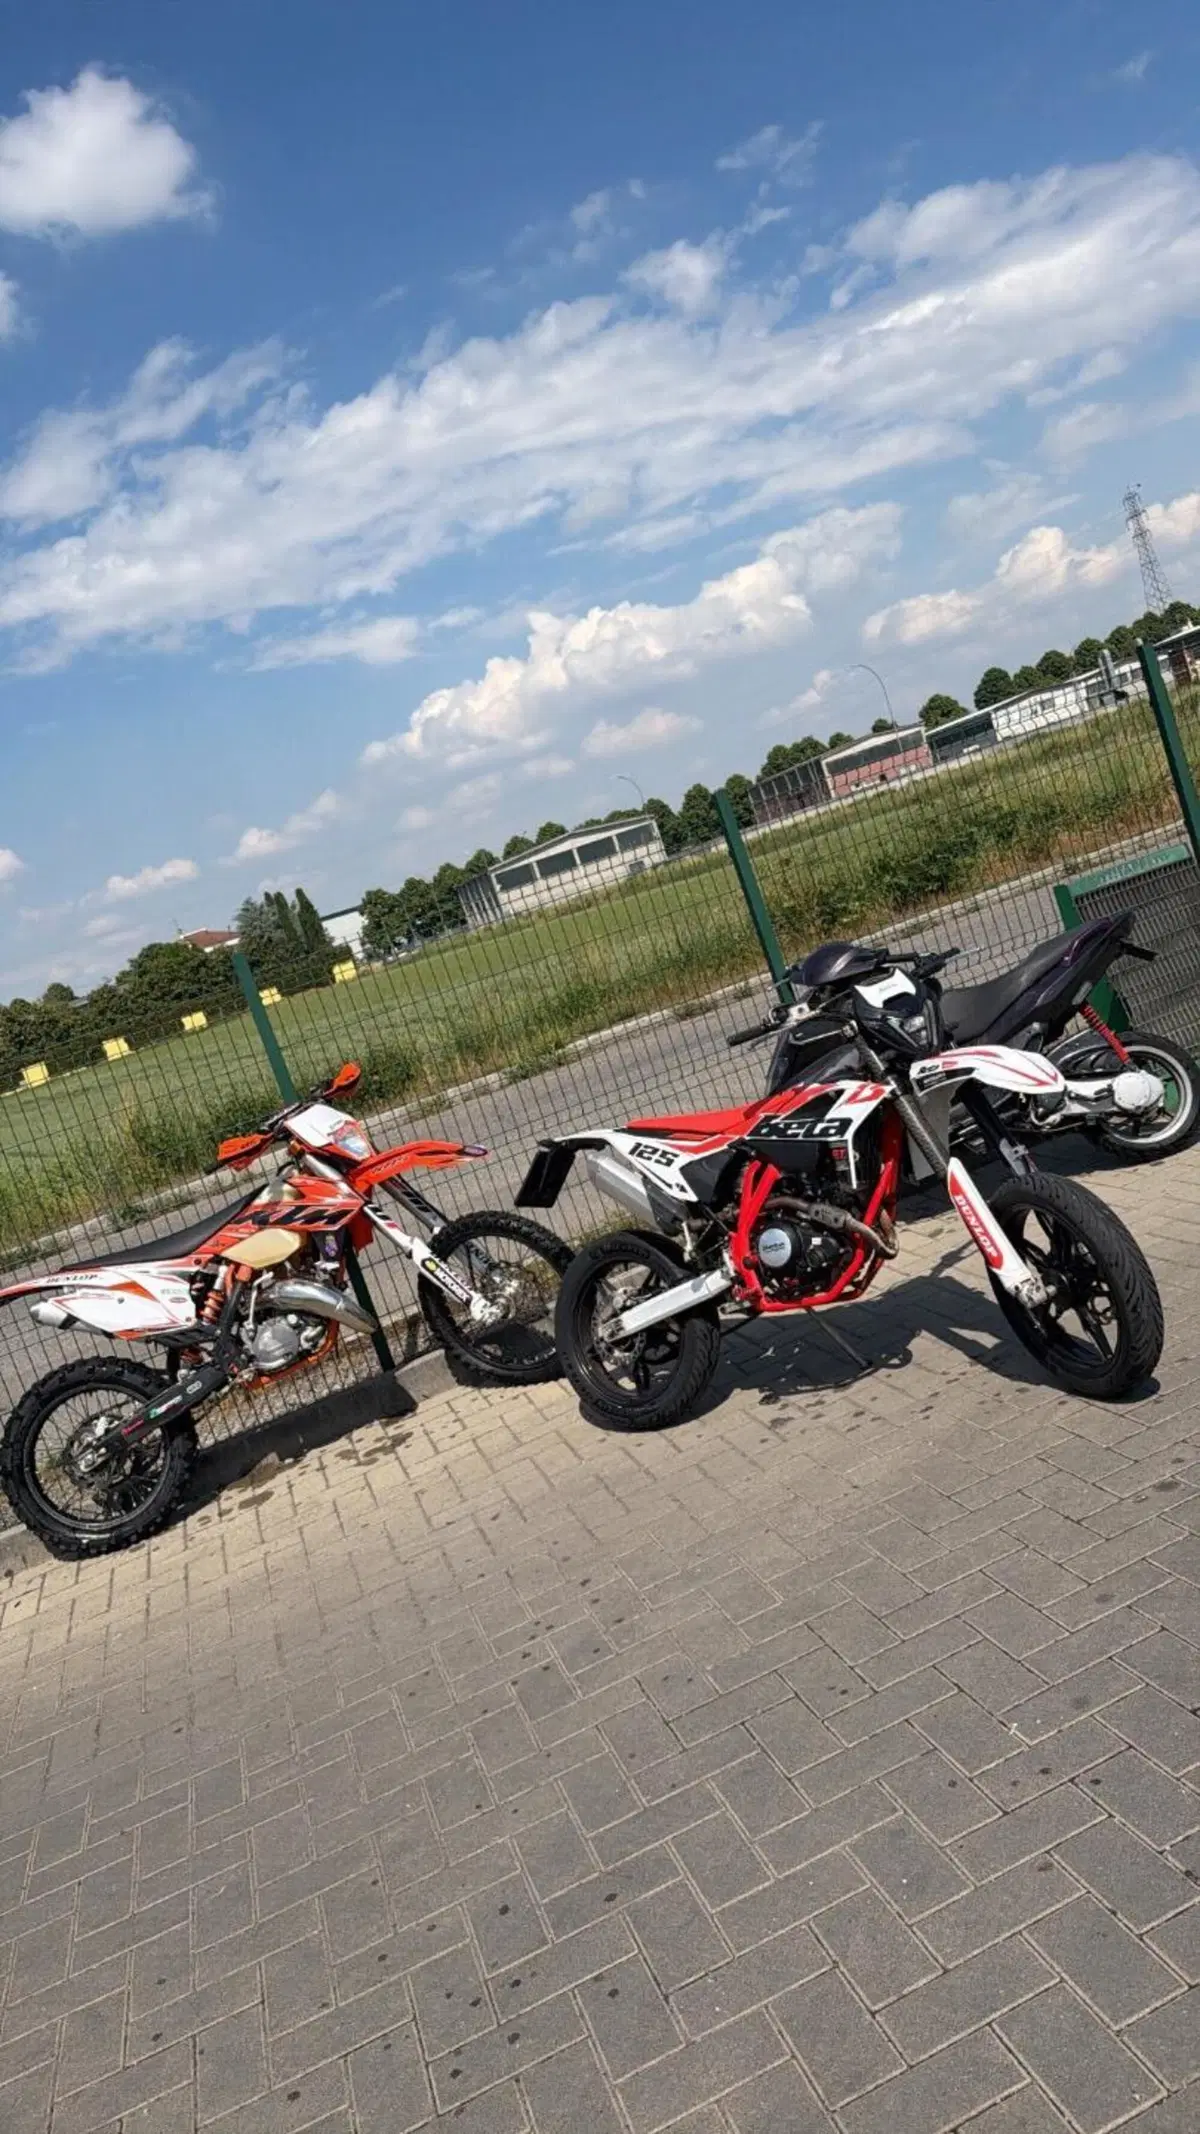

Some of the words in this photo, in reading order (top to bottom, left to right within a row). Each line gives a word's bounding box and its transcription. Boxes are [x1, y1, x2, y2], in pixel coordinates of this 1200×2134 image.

[628, 1142, 680, 1167] 125
[230, 1203, 354, 1228] KTM
[954, 1195, 998, 1258] DUNLOP
